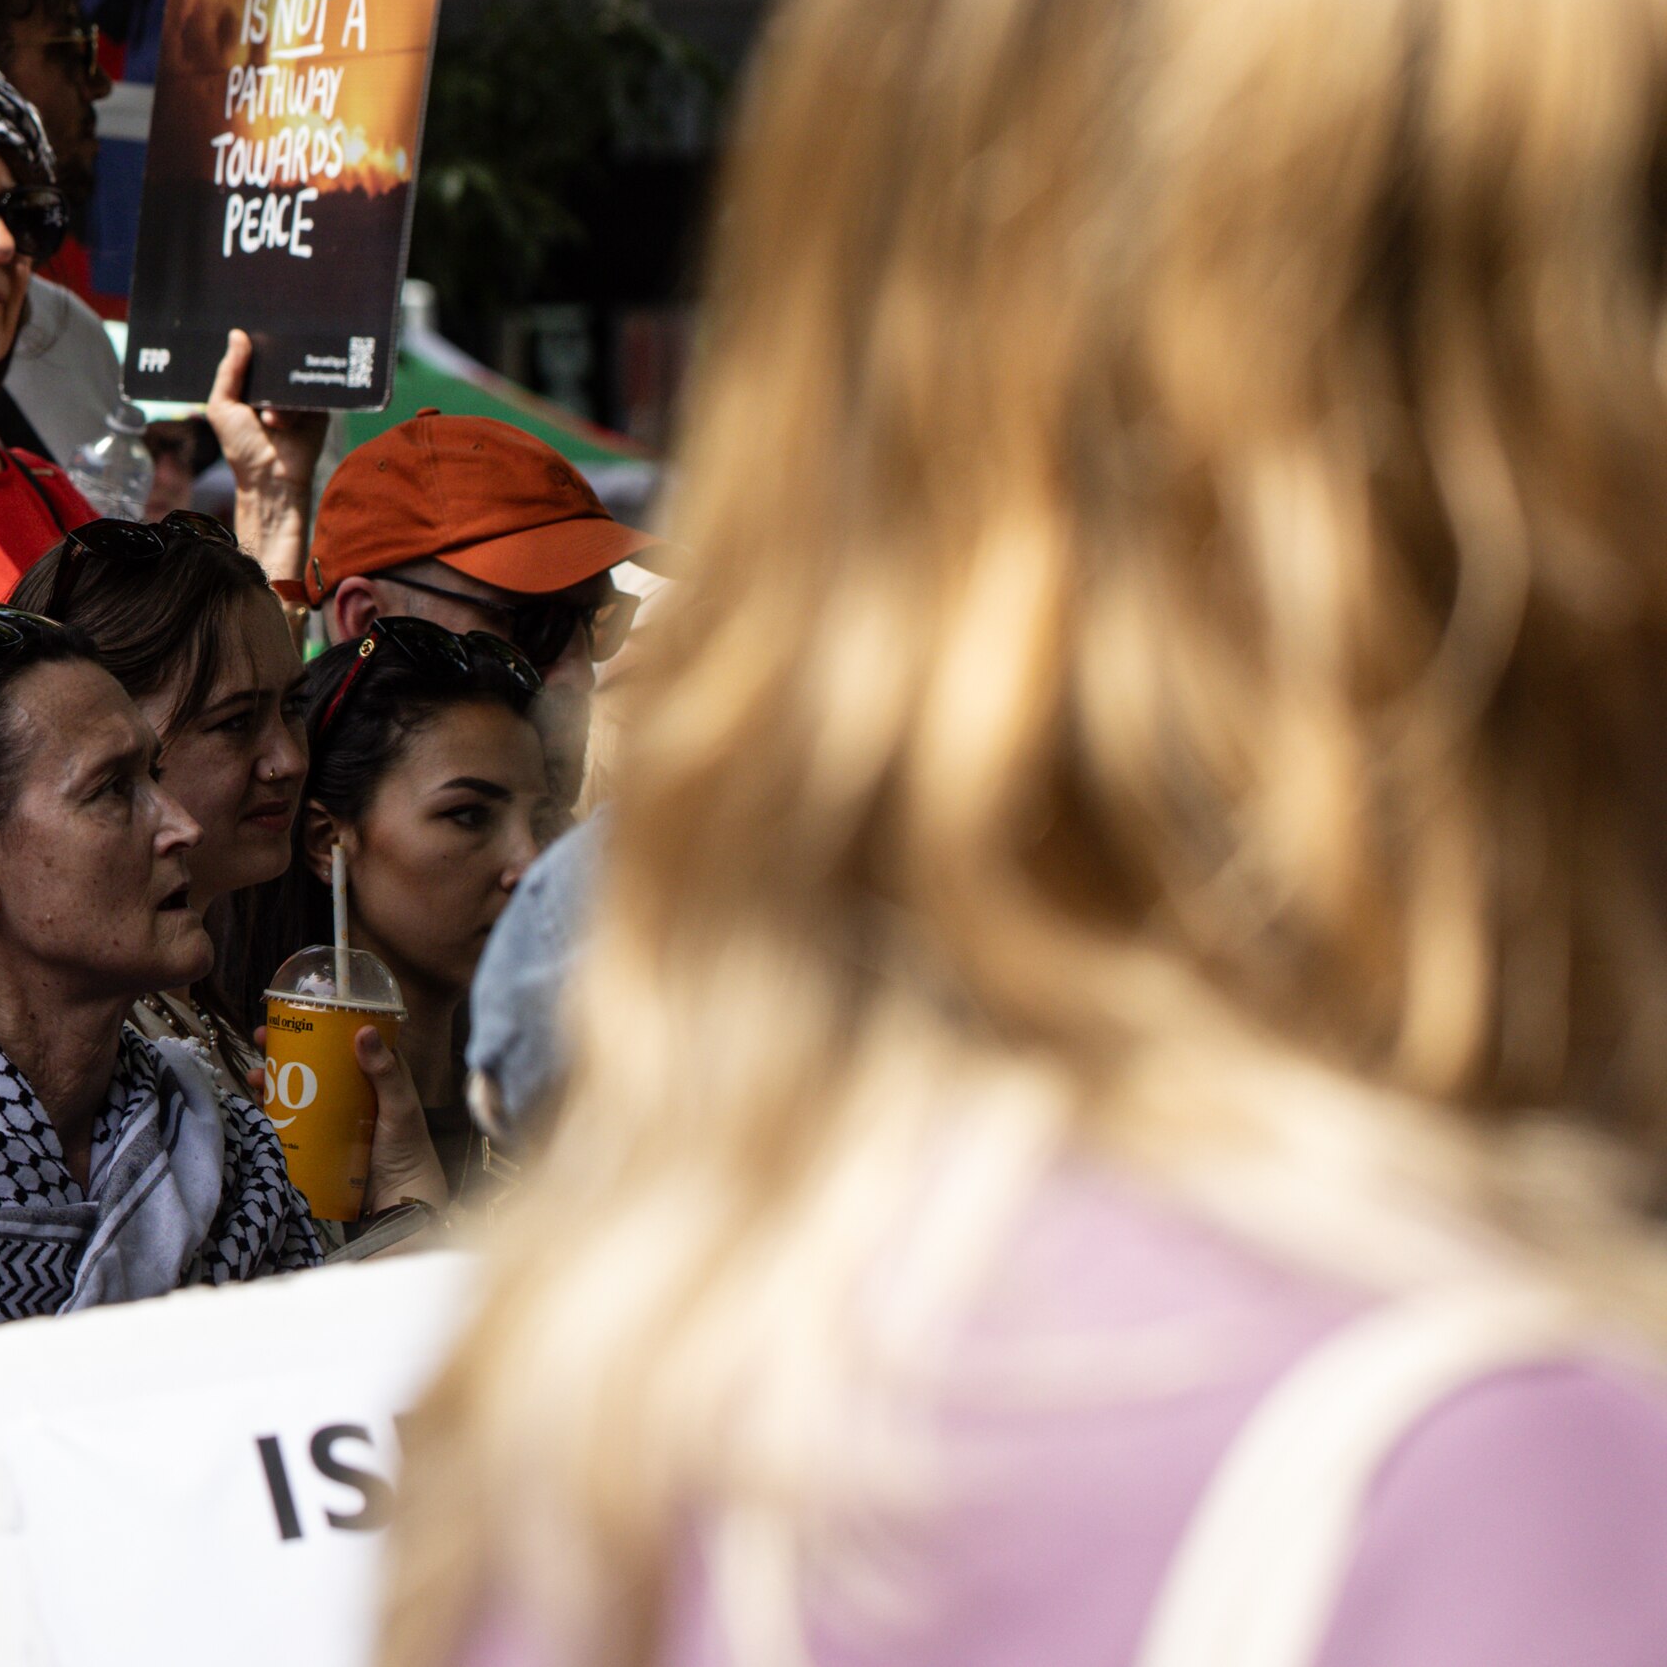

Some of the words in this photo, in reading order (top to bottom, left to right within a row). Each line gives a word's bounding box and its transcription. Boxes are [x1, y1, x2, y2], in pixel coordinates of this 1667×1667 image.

[225, 66, 343, 124] PATHWAY
[211, 124, 343, 187] TOWARDS
[223, 188, 318, 258] PEACE
[138, 348, 171, 372] FPP
[282, 1017, 314, 1033] origin
